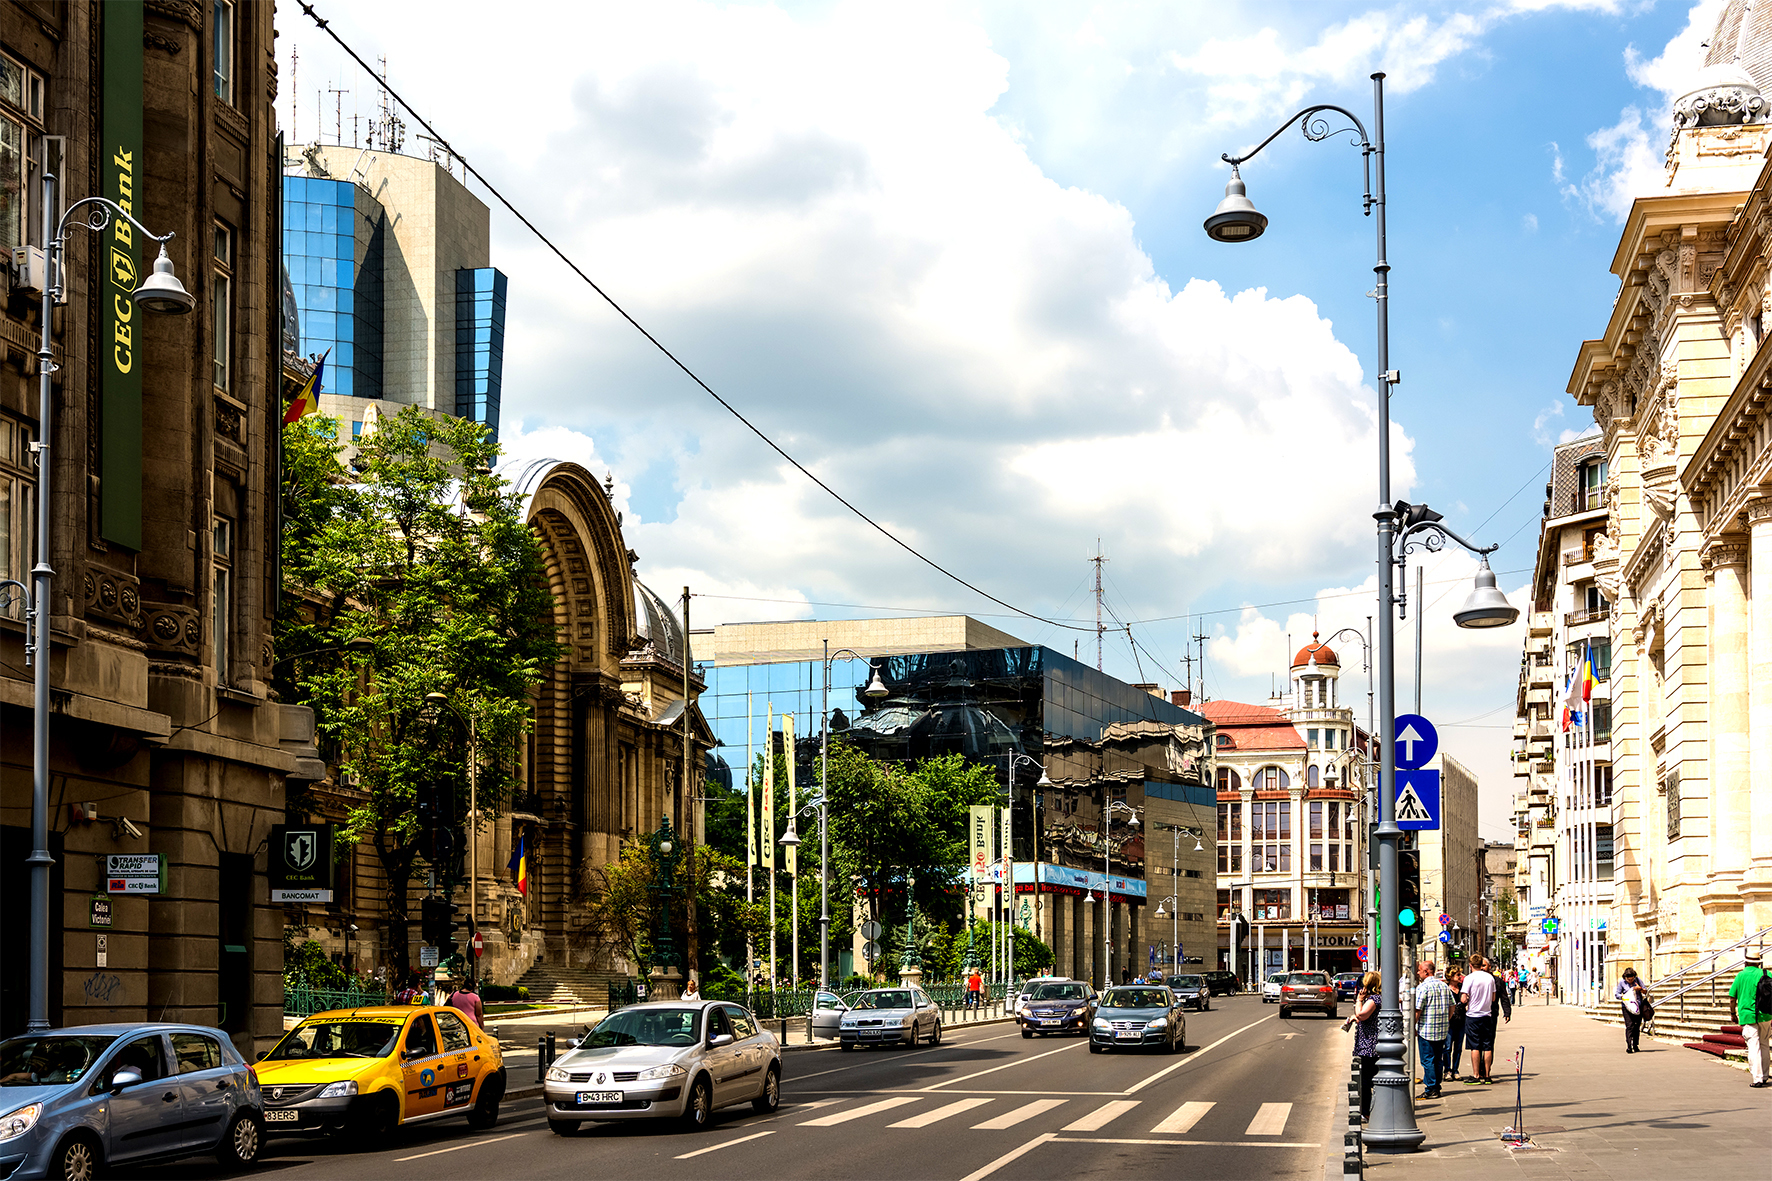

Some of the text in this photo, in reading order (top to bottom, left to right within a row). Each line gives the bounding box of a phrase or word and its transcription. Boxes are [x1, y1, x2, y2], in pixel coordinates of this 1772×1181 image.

[113, 145, 133, 374] CEC Bank
[118, 856, 158, 864] TRANSFER
[281, 892, 320, 900] BANCOMAT
[94, 902, 109, 913] Calea
[91, 914, 112, 925] Victoriei
[1301, 936, 1357, 946] ICTORIA
[602, 1092, 620, 1101] HRC
